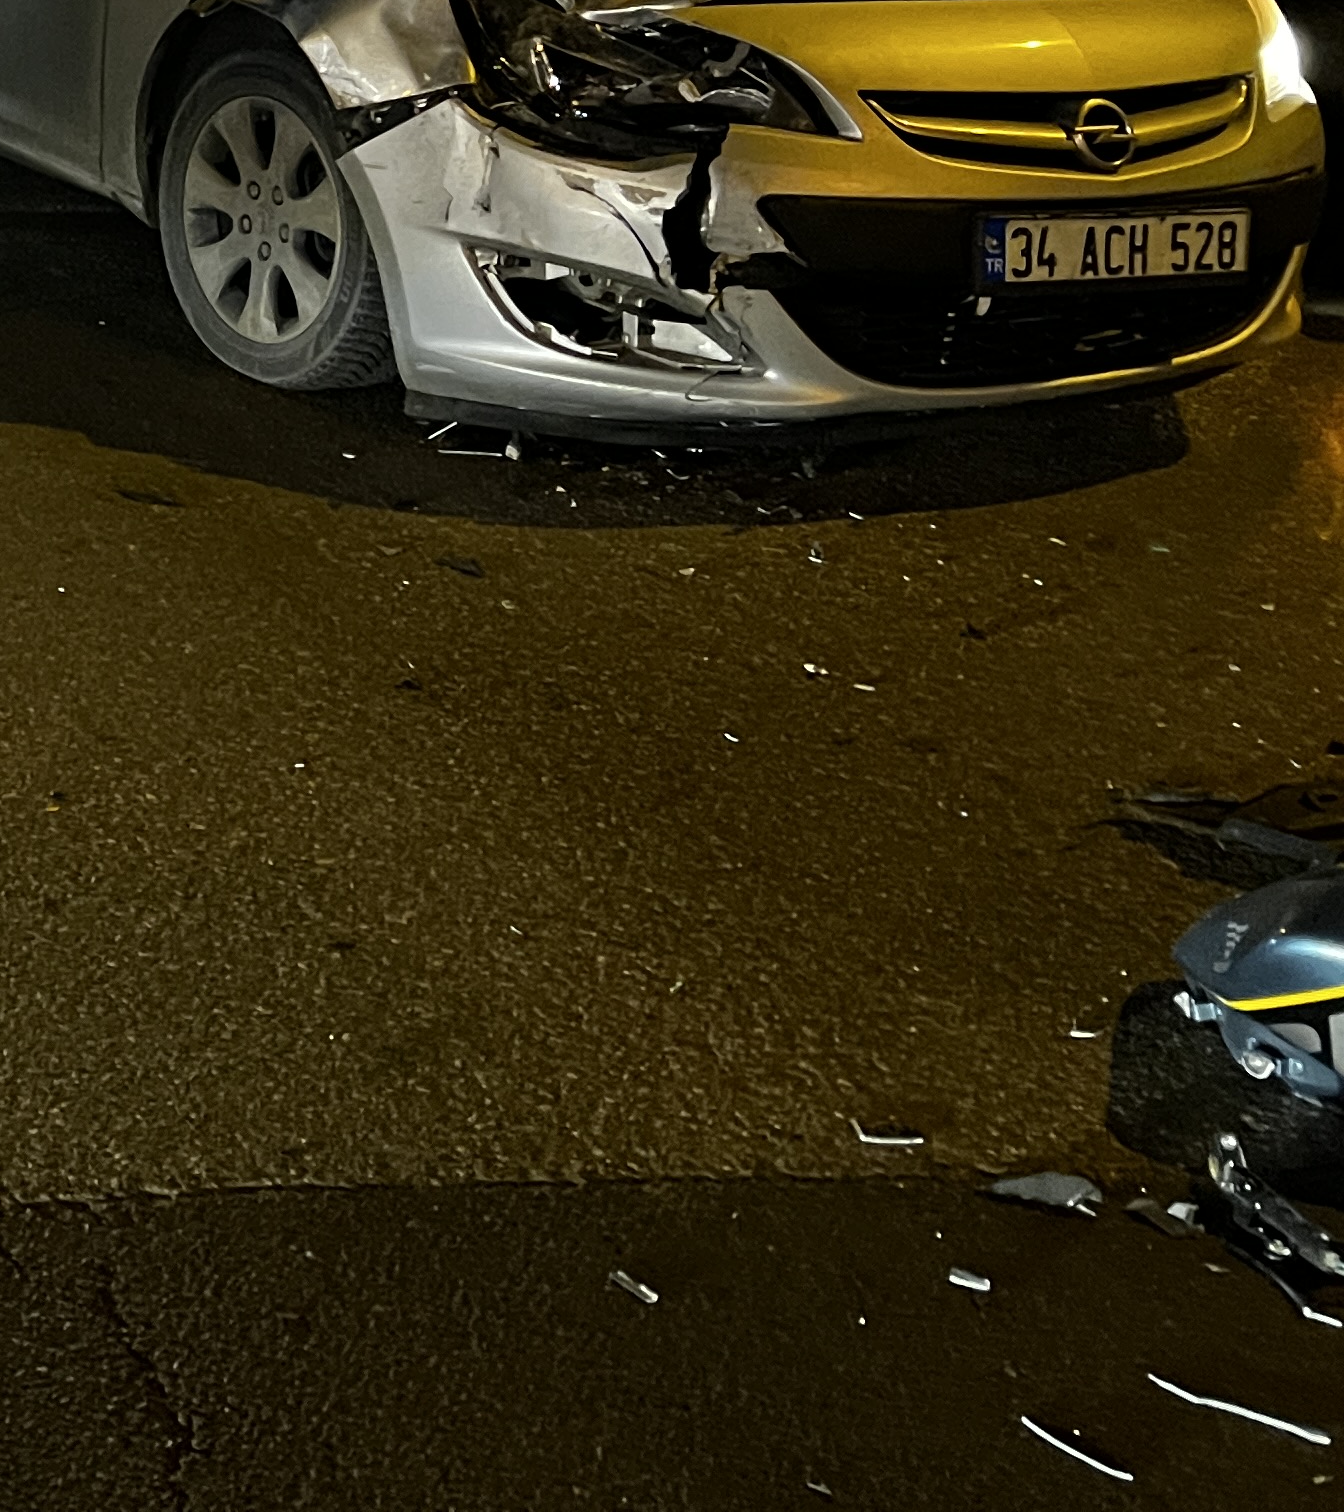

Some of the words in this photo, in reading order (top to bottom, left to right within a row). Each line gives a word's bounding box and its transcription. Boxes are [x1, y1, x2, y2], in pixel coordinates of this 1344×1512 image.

[985, 257, 1005, 274] TR
[1009, 226, 1058, 279] 34
[1080, 223, 1150, 277] ACH
[1170, 220, 1238, 273] 528
